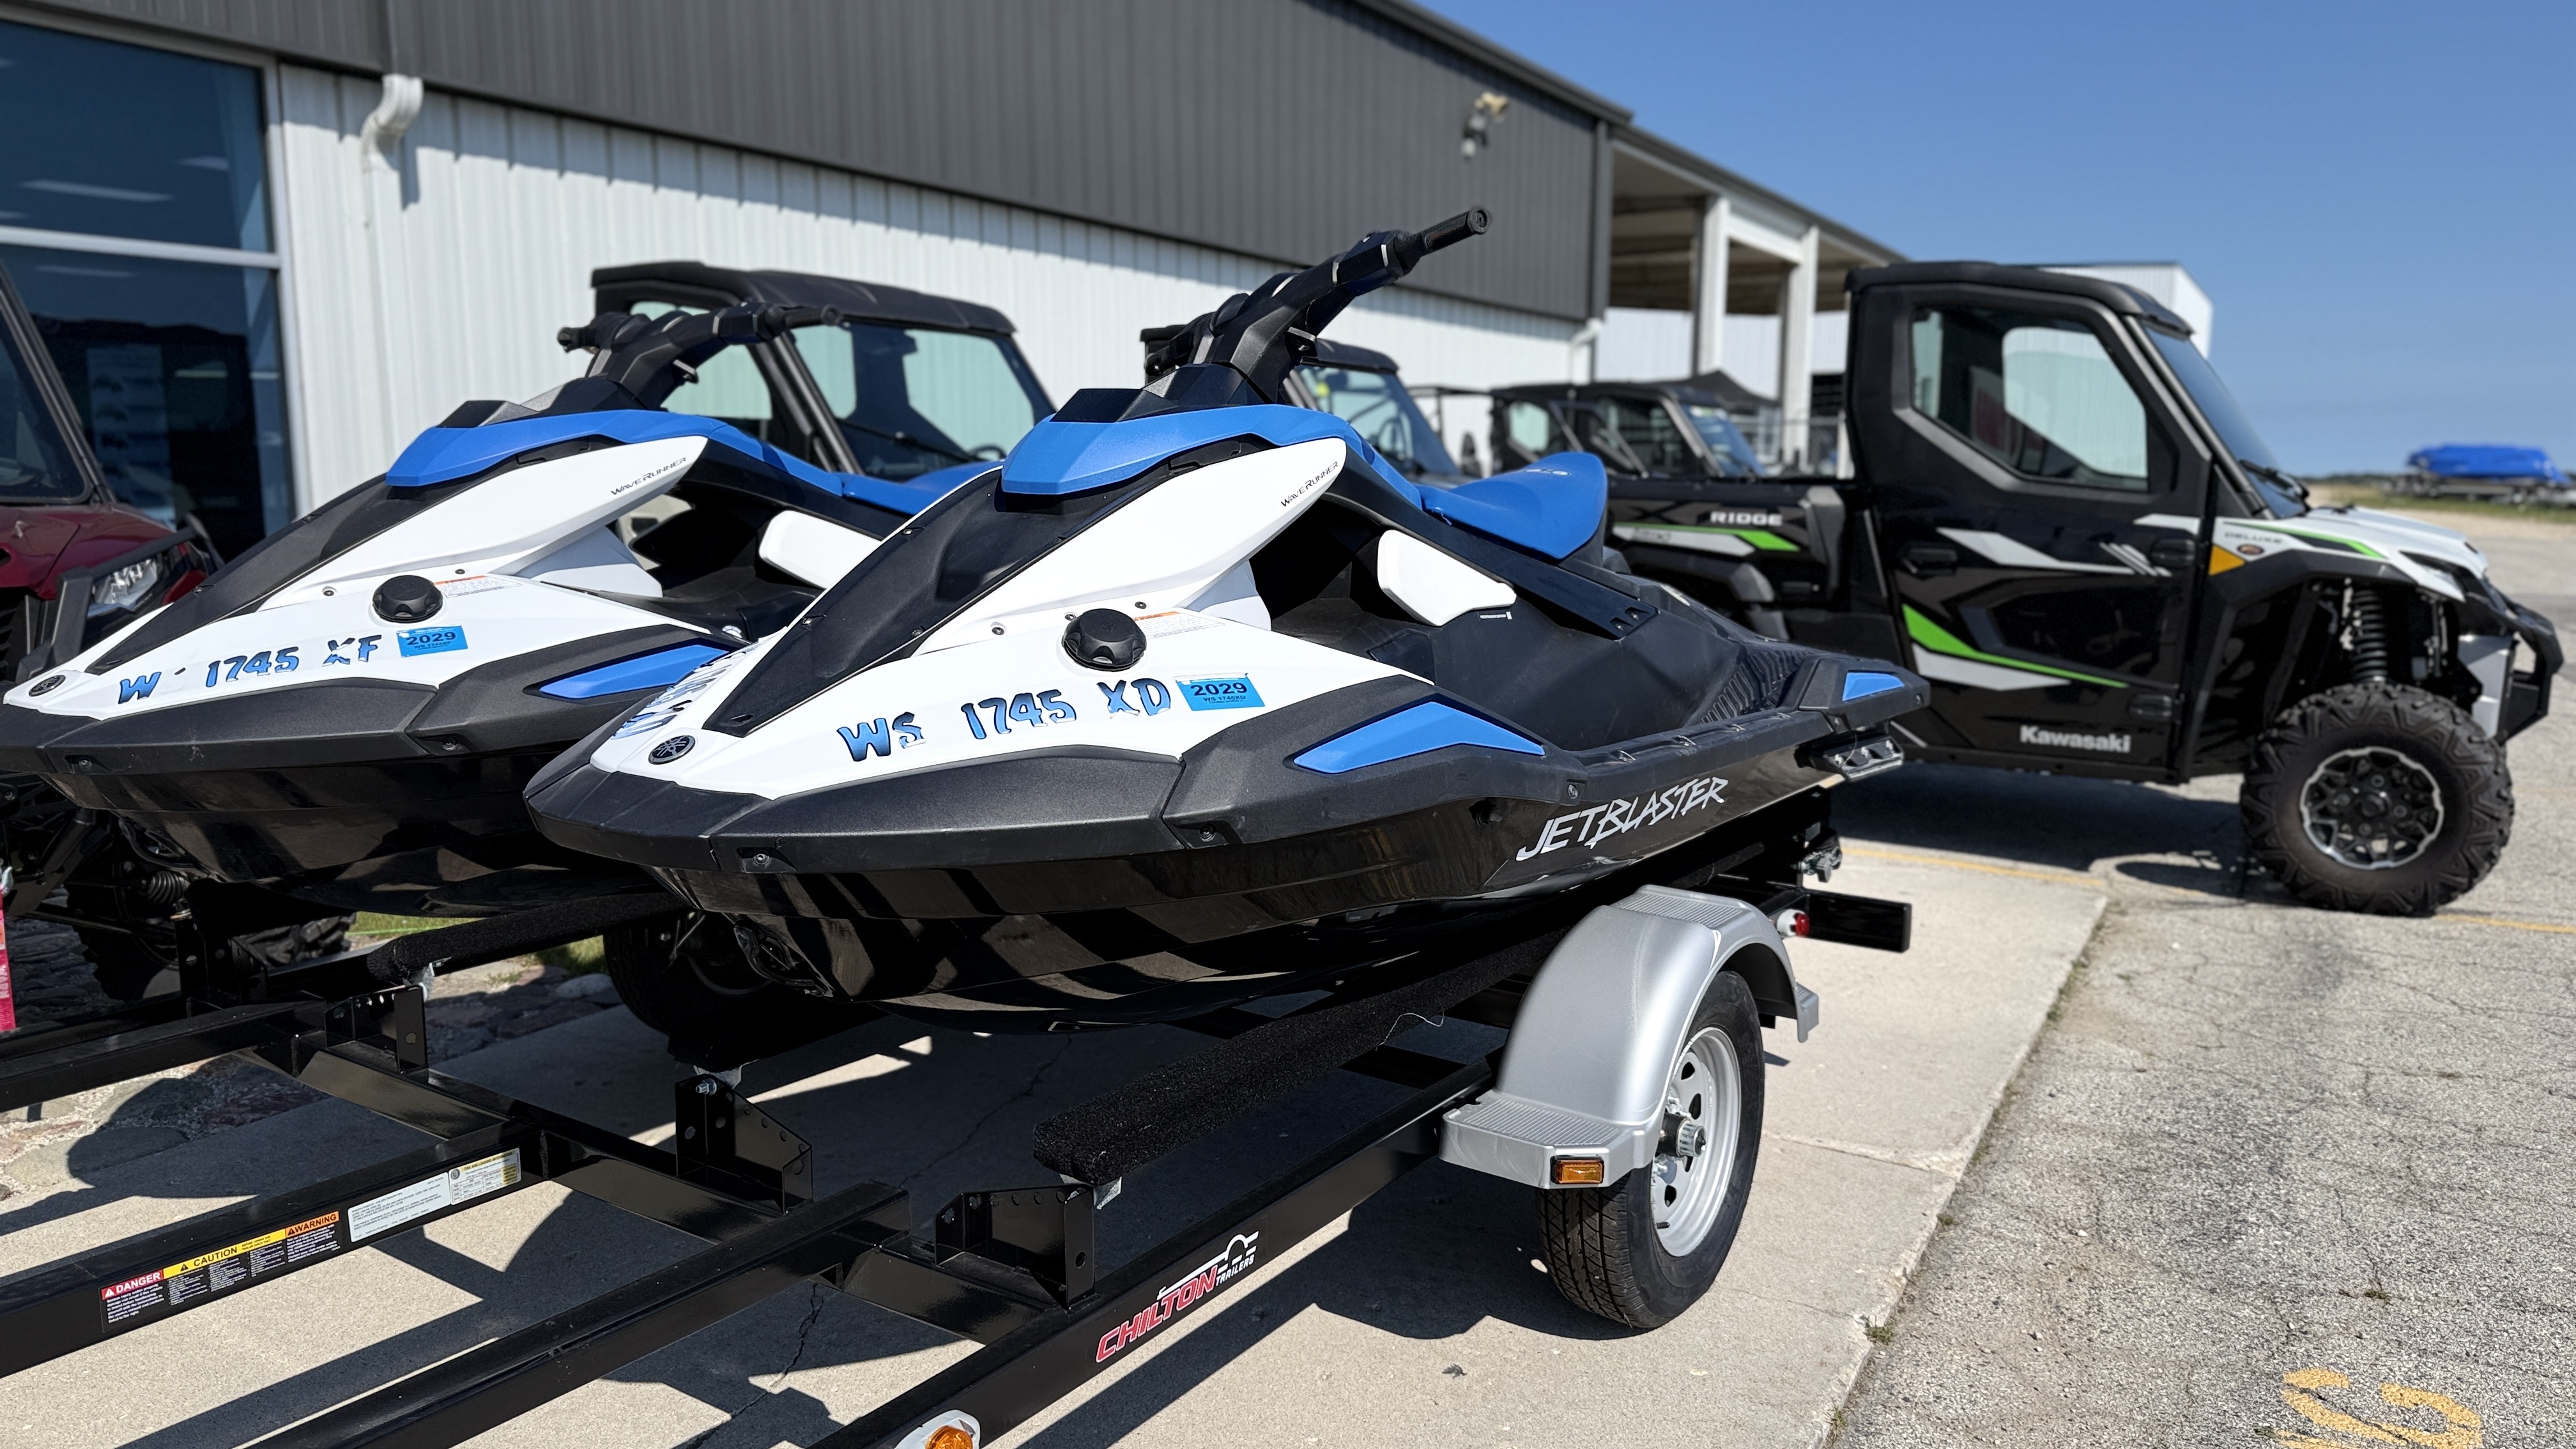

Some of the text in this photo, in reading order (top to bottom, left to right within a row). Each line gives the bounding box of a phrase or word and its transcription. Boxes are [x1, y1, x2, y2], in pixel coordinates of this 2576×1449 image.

[611, 457, 687, 495] WAVERUNNER
[1280, 461, 1338, 507] WAVERUNNER
[1710, 511, 1783, 526] RIDGE
[406, 632, 456, 645] 2029
[205, 646, 299, 687] 1745
[322, 634, 382, 667] XF
[1190, 682, 1247, 696] 2029
[836, 678, 1171, 762] WS 1745 XD
[2020, 725, 2131, 753] Kawasaki
[1515, 777, 1728, 861] JETBLASTER
[295, 1214, 337, 1233] WARNING
[194, 1246, 238, 1267] CAUTION
[116, 1272, 161, 1294] DANGER
[1095, 1254, 1255, 1363] CHILTON TRAILERS
